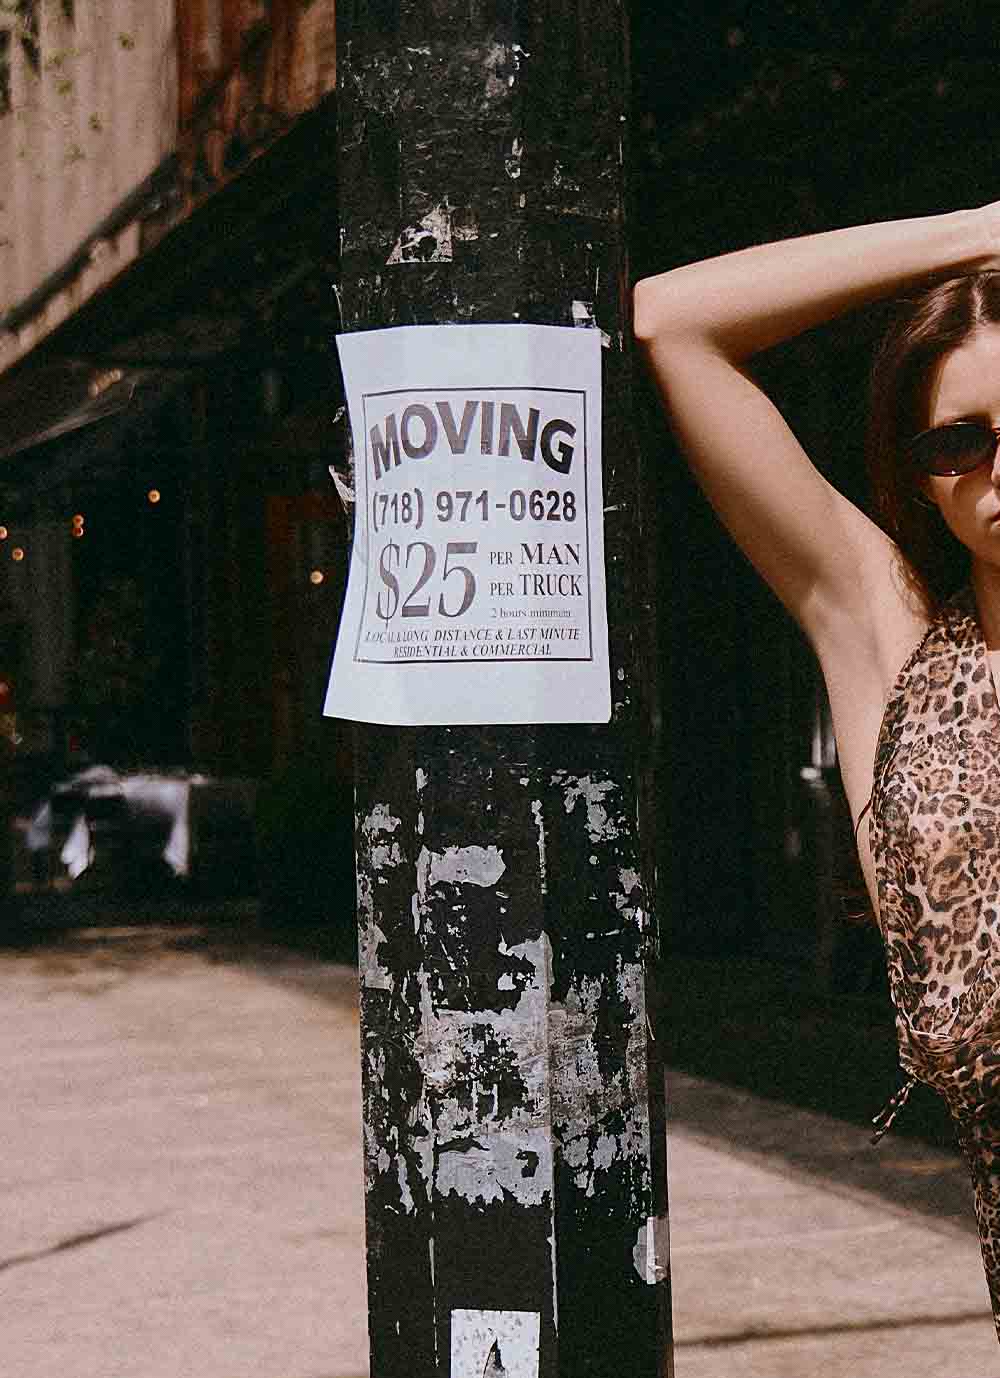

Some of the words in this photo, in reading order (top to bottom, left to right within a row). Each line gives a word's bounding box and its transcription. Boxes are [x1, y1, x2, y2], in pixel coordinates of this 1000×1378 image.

[369, 400, 577, 480] MOVING
[372, 488, 423, 533] (718)
[436, 490, 577, 522] 971-0628
[489, 551, 513, 565] PER
[520, 543, 580, 565] MAN
[375, 538, 478, 628] $25
[489, 582, 514, 596] PER
[519, 574, 583, 596] TRUCK
[434, 629, 493, 641] DISTANCE
[495, 629, 504, 640] &
[507, 628, 537, 641] LAST
[540, 628, 580, 640] MINUTE
[393, 645, 457, 658] RESIDENTIAL
[460, 645, 469, 657] &
[472, 643, 551, 657] COMMERCIAL
